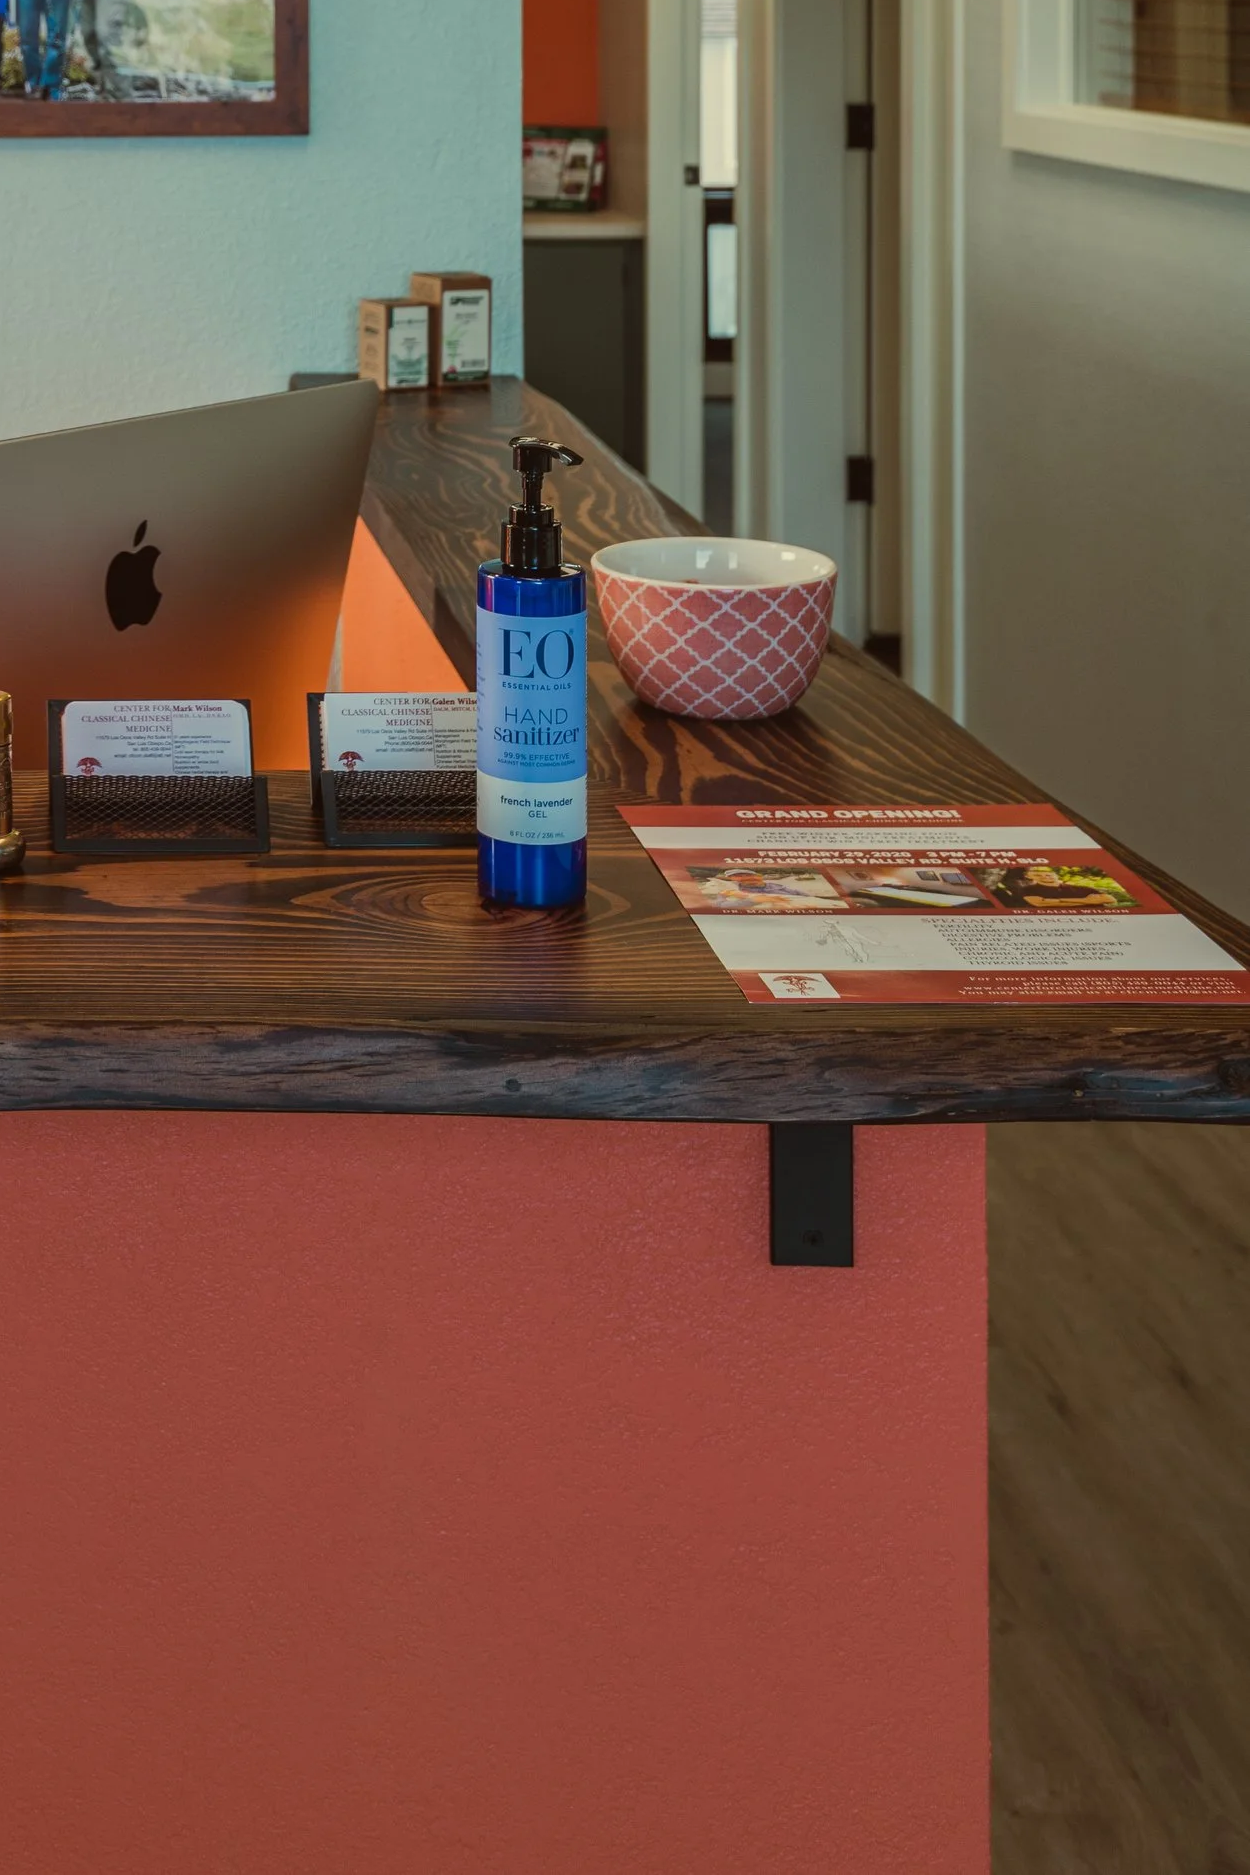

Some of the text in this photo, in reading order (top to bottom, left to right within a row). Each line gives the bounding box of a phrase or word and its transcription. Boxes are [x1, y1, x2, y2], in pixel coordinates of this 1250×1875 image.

[502, 681, 572, 691] ESSENTIAL OILS
[412, 697, 431, 705] FOR
[432, 697, 477, 705] Galen Wils
[341, 708, 389, 716] CLASSICAL
[504, 706, 568, 725] HAND
[81, 715, 129, 723] CLASSICAL
[493, 726, 580, 746] sanitizer
[503, 751, 570, 761] 99.9% EFFECTIVE
[500, 795, 573, 808] french lavender
[736, 810, 962, 819] GRAND OPENING!
